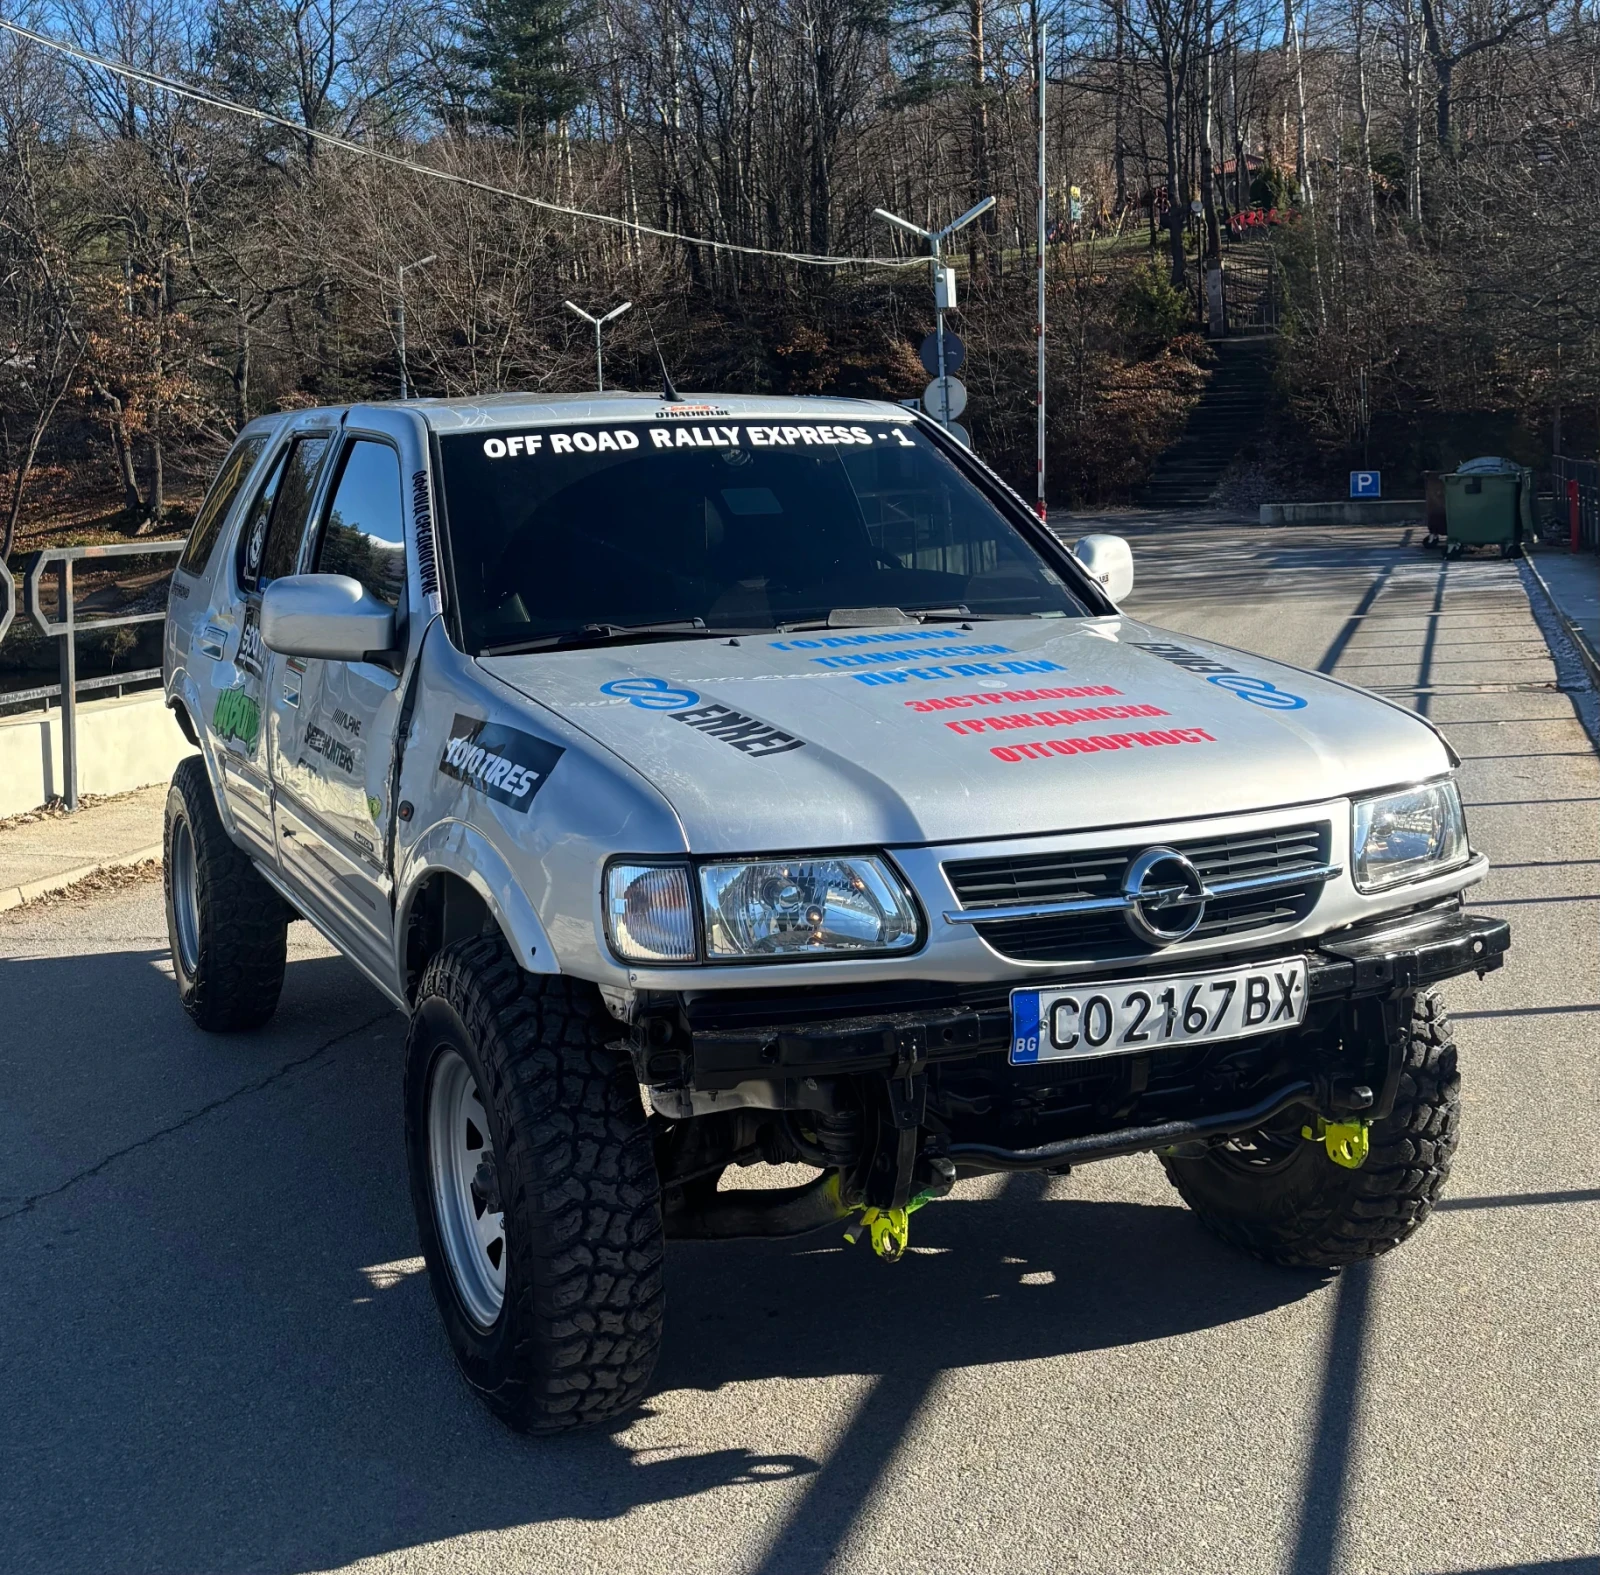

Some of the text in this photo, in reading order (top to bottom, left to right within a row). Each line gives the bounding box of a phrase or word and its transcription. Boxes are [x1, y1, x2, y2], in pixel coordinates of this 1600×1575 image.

[483, 437, 543, 458] OFF
[549, 430, 640, 454] ROAD
[649, 426, 740, 448] RALLY
[746, 425, 873, 446] EXPRESS
[891, 428, 916, 447] 1
[1358, 473, 1372, 492] P
[768, 630, 968, 651] ГОДИШНИ
[811, 644, 1016, 669] ТЕХНИЧЕСКИ
[1126, 641, 1241, 674] ENKEI
[852, 659, 1068, 687] ПРЕГЛЕДИ
[904, 685, 1124, 712] ЗАСТРАХОВКИ
[668, 704, 806, 758] ENKEI
[945, 704, 1173, 735] ГРАЖДАНСКА
[989, 727, 1218, 763] ОТГОВОРНОСТ
[446, 737, 540, 798] TOYO TIRES
[1122, 979, 1238, 1043] 2167
[1242, 969, 1299, 1028] BX
[1015, 1037, 1038, 1053] BG
